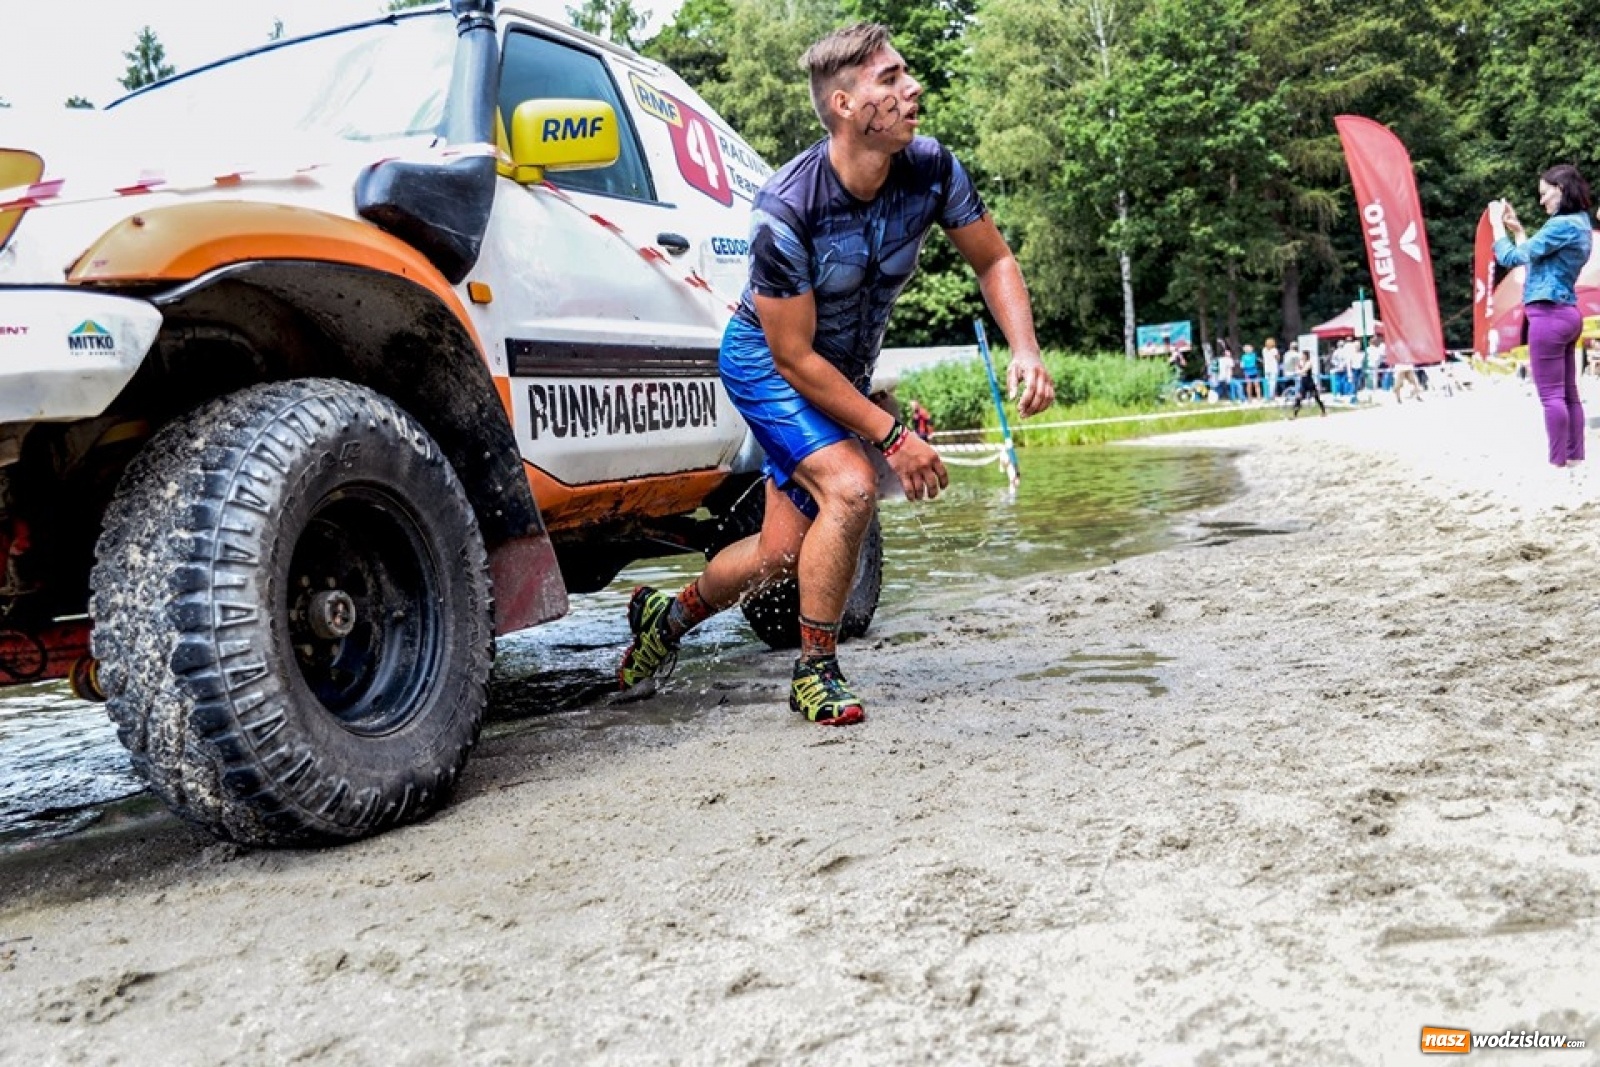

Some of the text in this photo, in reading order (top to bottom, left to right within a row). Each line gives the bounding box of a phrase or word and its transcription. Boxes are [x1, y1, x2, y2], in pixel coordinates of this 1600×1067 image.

[637, 84, 677, 120] RMF
[542, 116, 604, 142] RMF
[686, 118, 720, 191] 4
[68, 335, 114, 349] MITKO
[528, 381, 718, 440] RUNMAGEDDON
